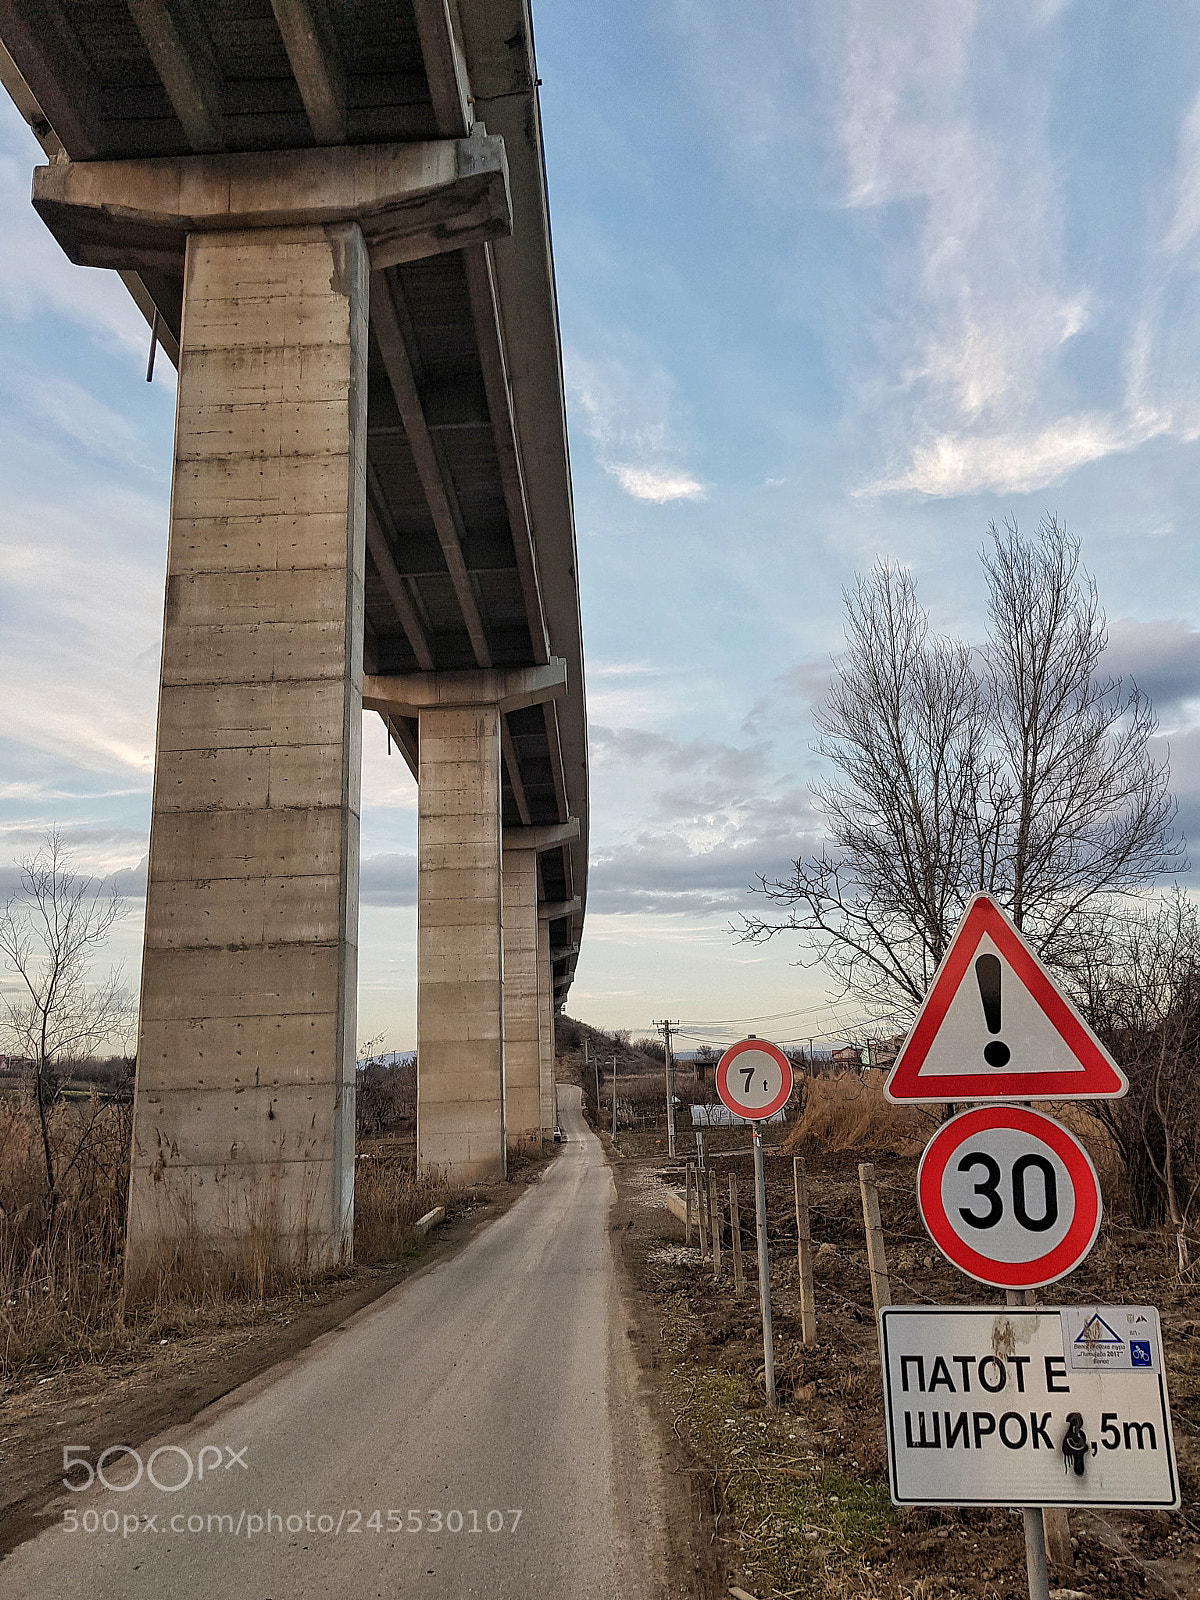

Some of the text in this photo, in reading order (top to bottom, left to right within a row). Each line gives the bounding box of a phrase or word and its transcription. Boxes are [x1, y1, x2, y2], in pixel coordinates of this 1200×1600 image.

[739, 1068, 769, 1094] 7 t
[957, 1151, 1058, 1233] 30
[900, 1355, 1071, 1393] ПАТОТ Е
[904, 1410, 1055, 1450] ШИРОК
